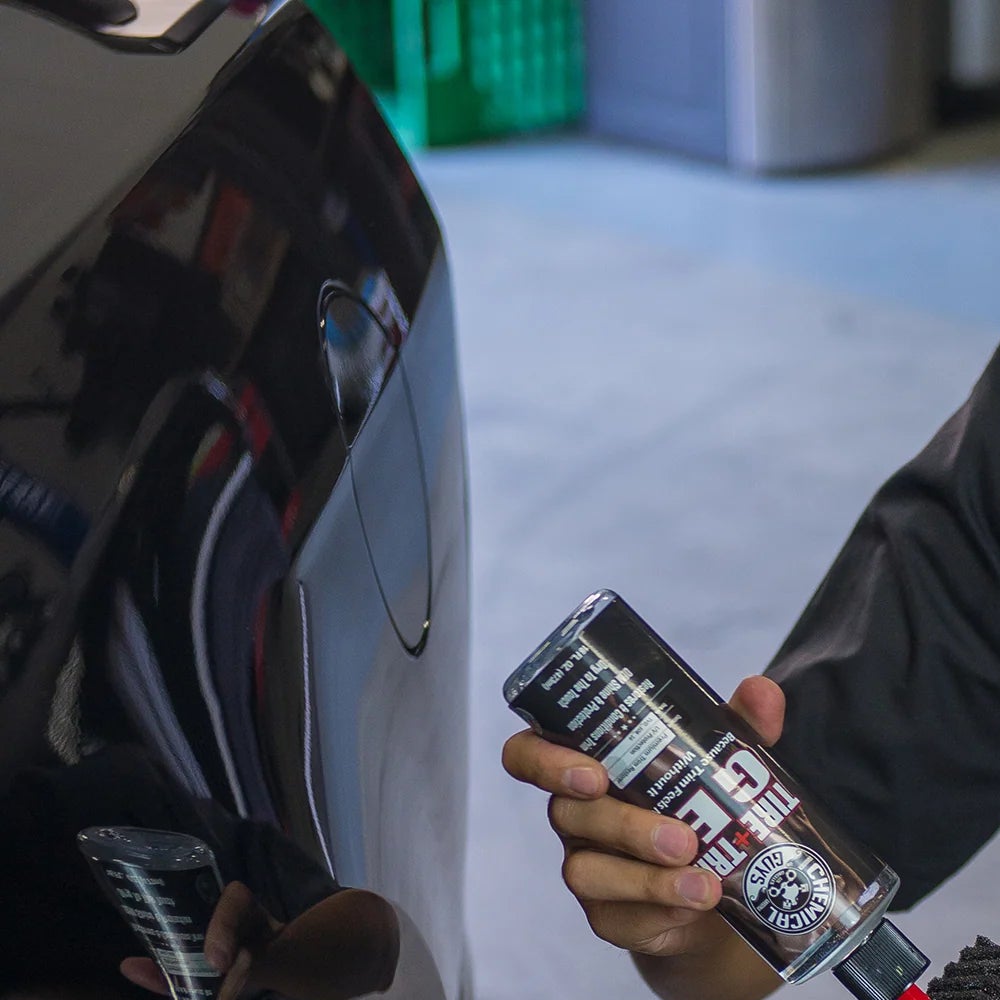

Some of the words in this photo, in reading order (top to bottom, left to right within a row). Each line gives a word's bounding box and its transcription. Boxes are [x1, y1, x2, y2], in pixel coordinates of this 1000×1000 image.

[583, 670, 597, 683] To
[588, 658, 608, 675] Dry
[572, 677, 590, 694] The
[598, 678, 621, 700] Shine
[623, 677, 654, 707] Restores
[556, 687, 579, 709] Touch
[565, 700, 599, 732] Protection
[589, 708, 624, 741] Conditions
[578, 736, 596, 752] Trim
[629, 732, 653, 755] Protection
[643, 732, 667, 756] Premium
[698, 731, 736, 767] Because
[633, 755, 646, 767] Trim
[652, 749, 696, 791] Without
[615, 765, 635, 784] Restorer
[677, 763, 704, 789] Trim
[645, 786, 658, 798] It
[656, 785, 682, 811] Feels
[677, 749, 772, 843] GE
[750, 851, 783, 885] GUYS
[768, 863, 829, 929] CHEMICAL
